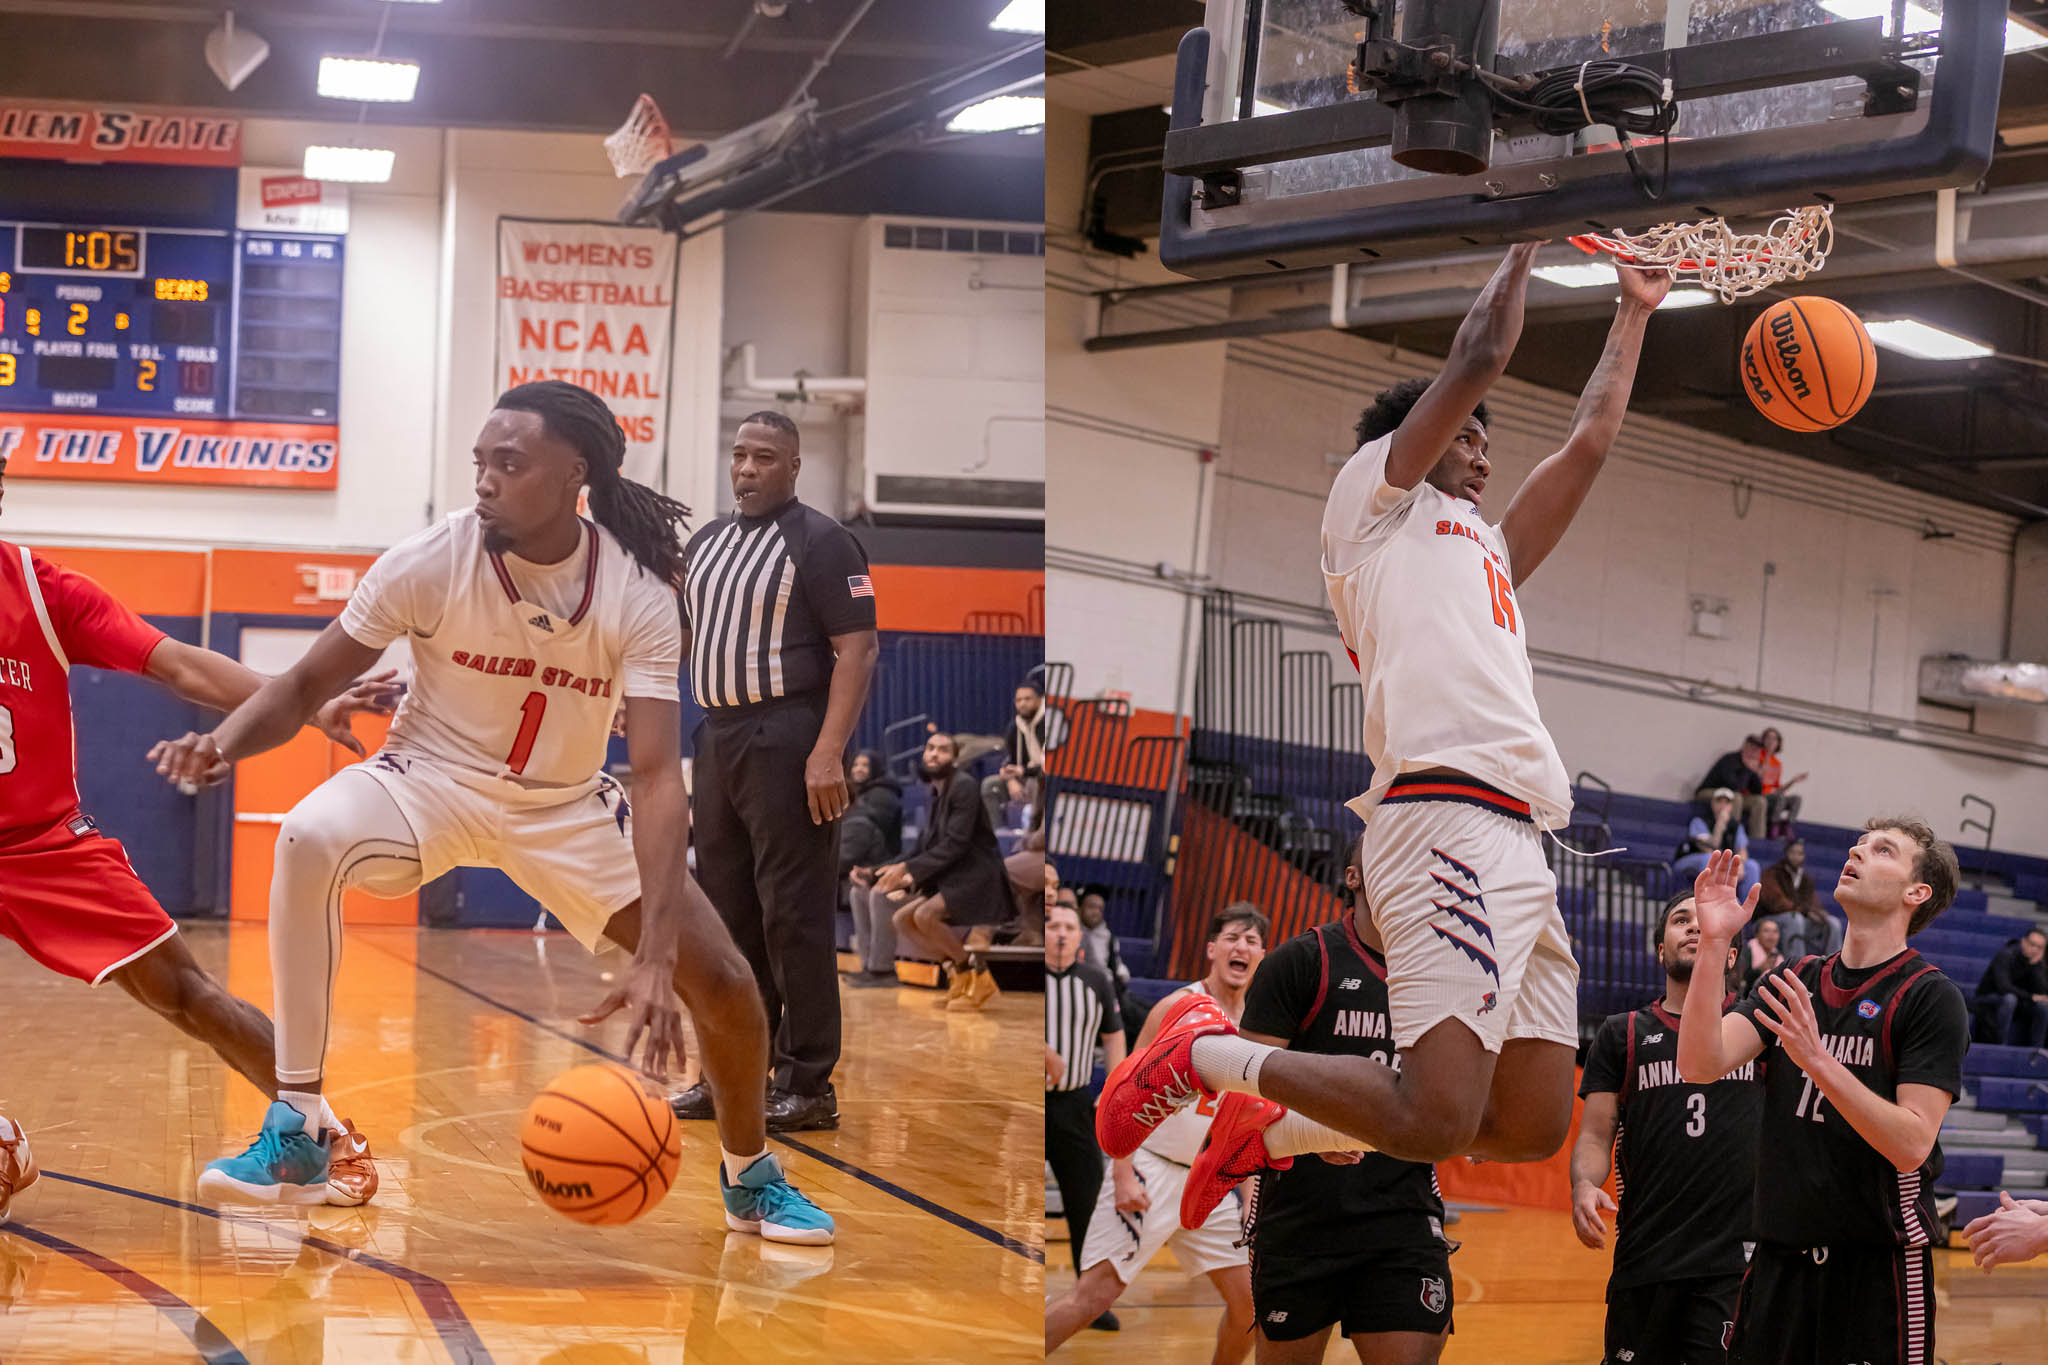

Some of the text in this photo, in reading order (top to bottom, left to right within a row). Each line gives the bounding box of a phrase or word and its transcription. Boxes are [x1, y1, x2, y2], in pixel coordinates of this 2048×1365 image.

[91, 109, 242, 151] STATE
[65, 231, 138, 270] 1:05
[522, 240, 654, 269] WOMEN'S
[497, 277, 672, 307] BASKETBALL
[67, 303, 89, 335] 2
[519, 318, 651, 357] NCAA
[137, 359, 157, 391] 2
[1744, 341, 1774, 405] NCAA
[1770, 311, 1811, 400] Wilson
[35, 428, 122, 465] THE
[134, 426, 336, 473] VIKINGS
[1483, 556, 1517, 636] 15
[452, 650, 537, 678] SALEM
[505, 691, 548, 776] 1
[1333, 1009, 1386, 1039] ANNA
[1820, 1033, 1874, 1067] MARIA
[1686, 1092, 1707, 1138] 3
